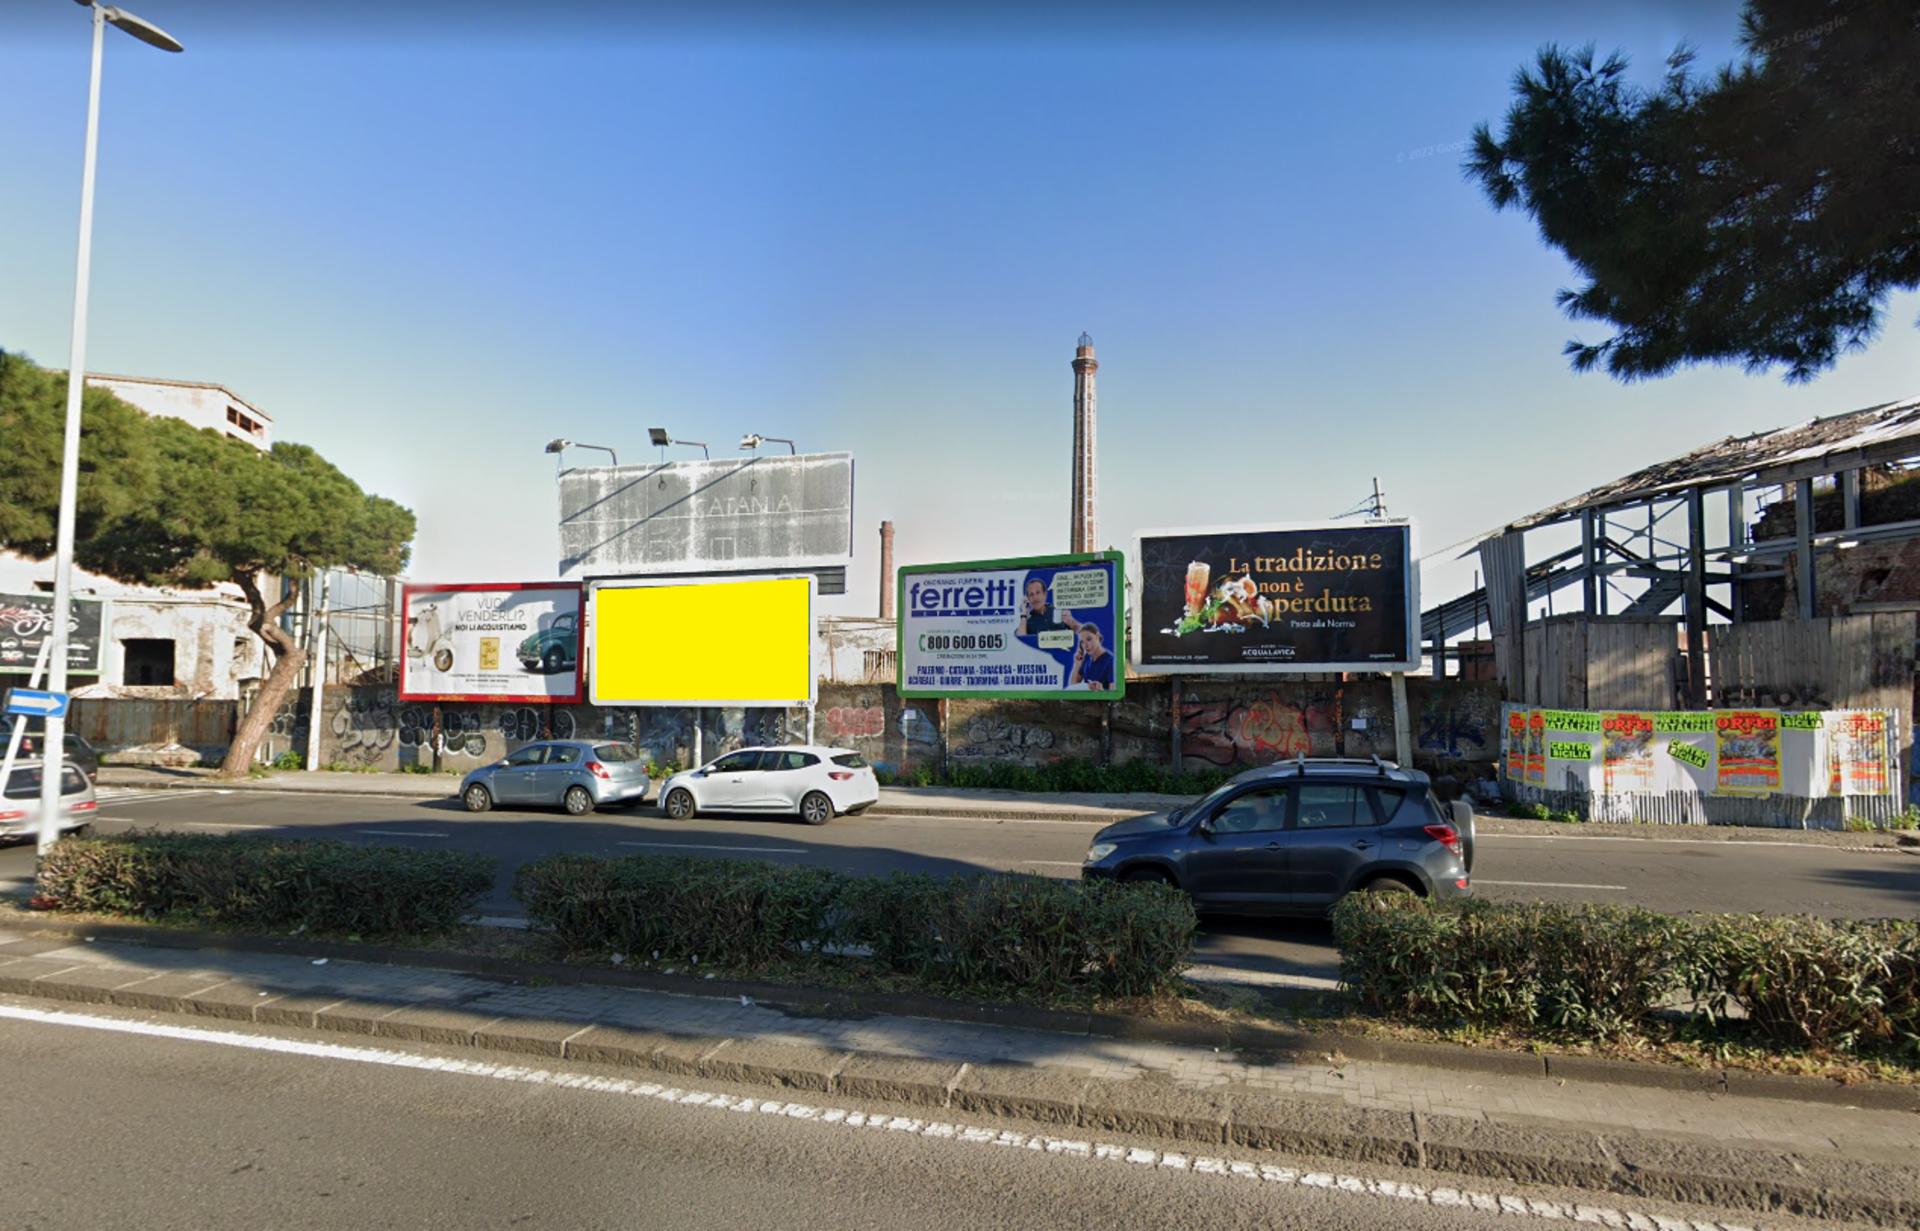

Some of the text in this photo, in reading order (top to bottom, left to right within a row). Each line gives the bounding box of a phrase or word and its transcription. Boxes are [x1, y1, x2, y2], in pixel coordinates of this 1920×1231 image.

[1230, 546, 1382, 573] La tradizione
[1259, 576, 1305, 593] non è
[910, 579, 1015, 609] ferretti
[1273, 588, 1373, 621] perduta
[458, 609, 525, 622] VENDERLI?
[1327, 619, 1356, 628] Norma
[455, 624, 468, 632] NOI
[476, 623, 528, 632] ACQUISTIAMO
[927, 634, 1003, 650] 800 600 605
[1242, 648, 1296, 656] ACQUALAVICA
[1602, 718, 1653, 736] ORFEI
[1717, 717, 1776, 735] ORFEI
[1551, 742, 1592, 751] CENTRO
[1552, 750, 1590, 759] SICILIA
